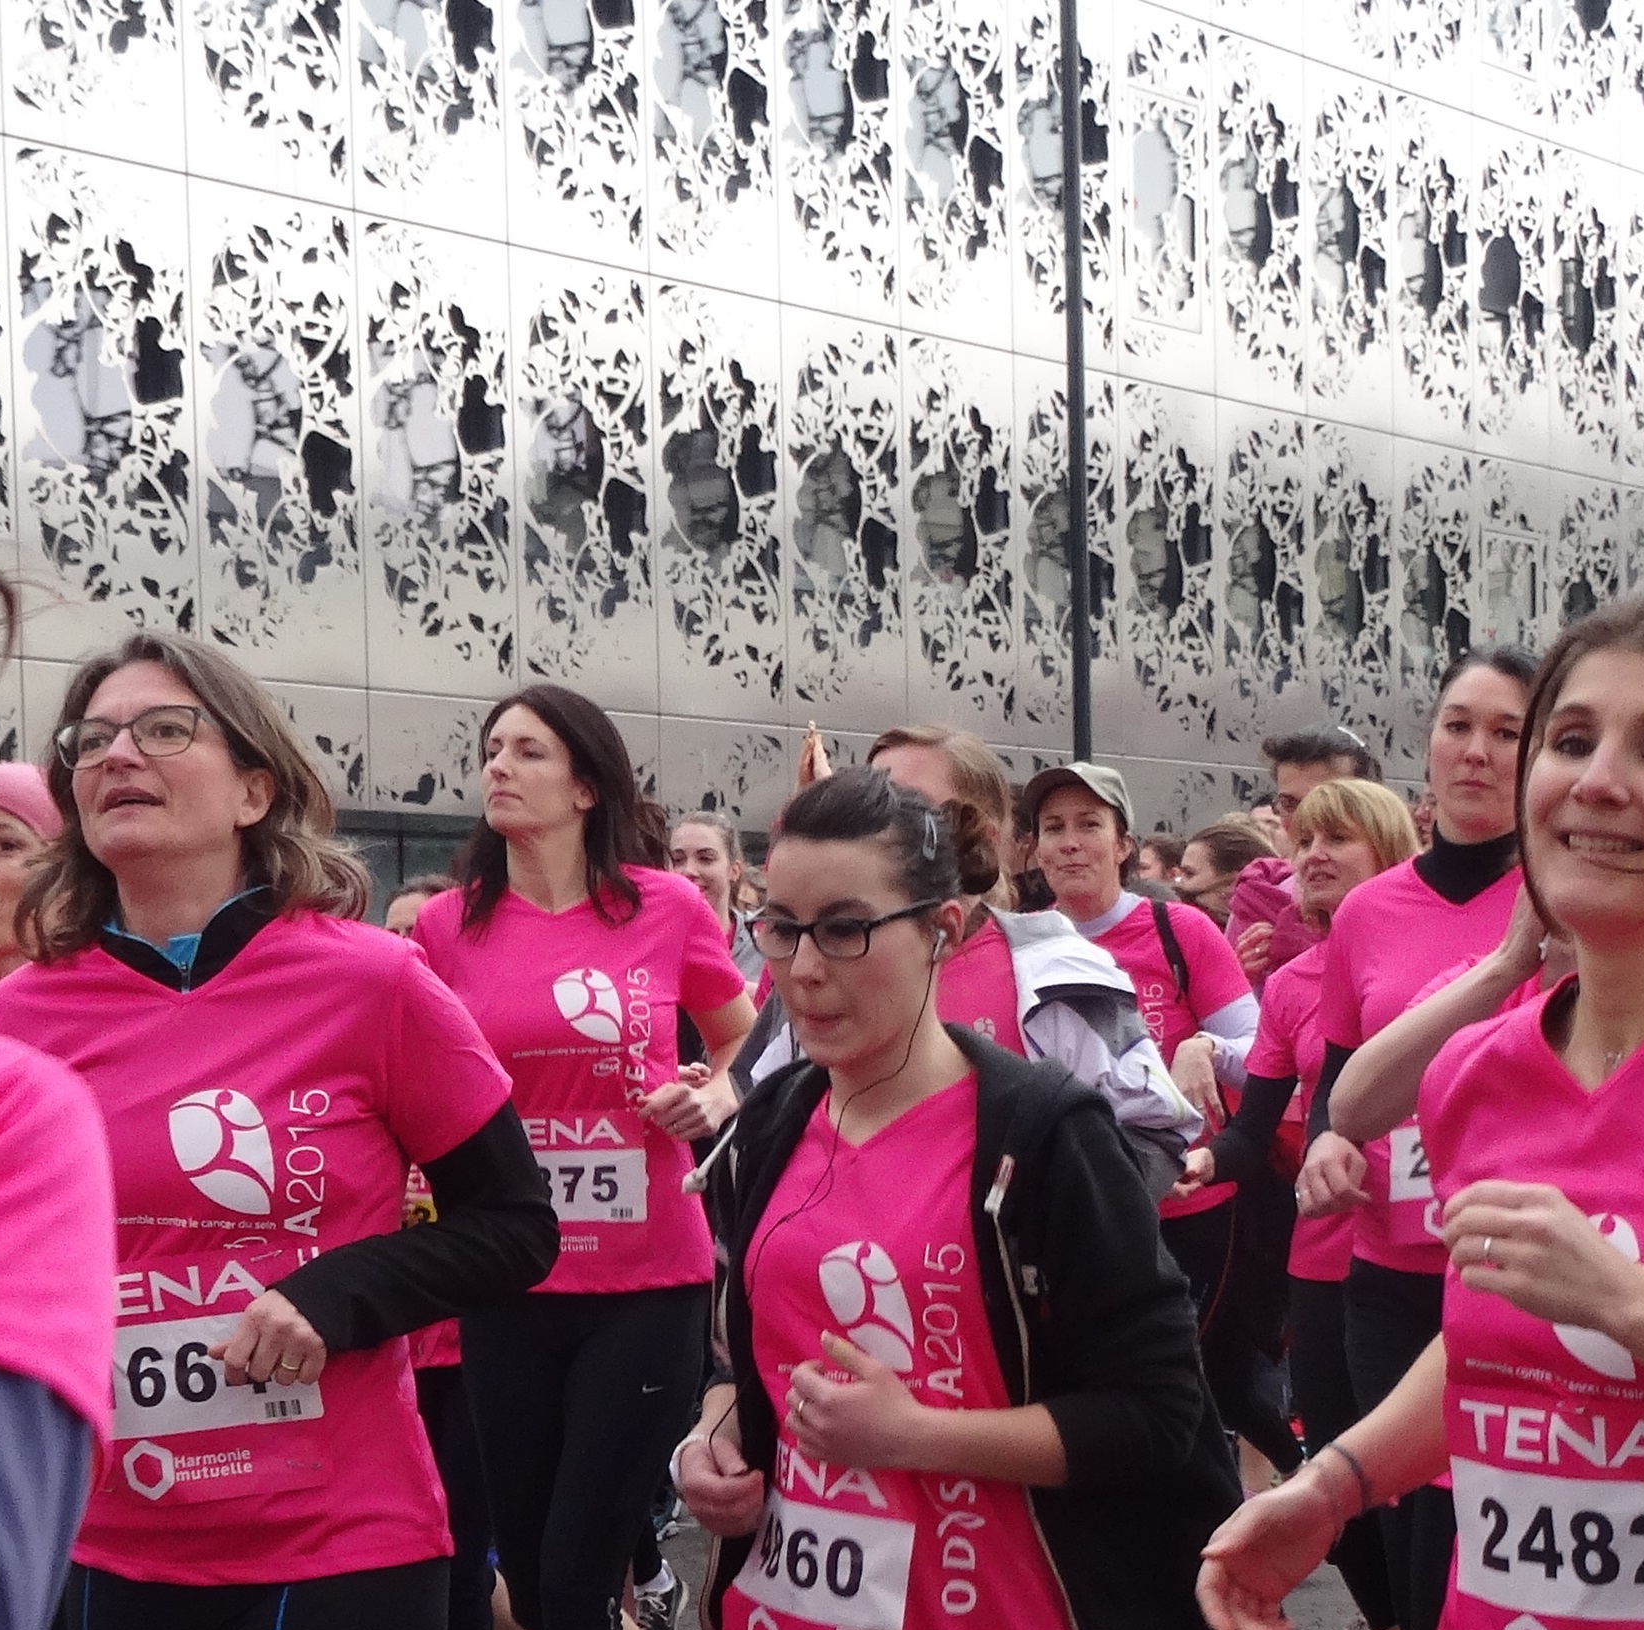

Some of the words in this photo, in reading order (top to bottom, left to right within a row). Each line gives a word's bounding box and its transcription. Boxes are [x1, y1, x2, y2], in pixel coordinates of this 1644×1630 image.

[521, 1116, 626, 1147] ENA
[117, 1214, 155, 1226] semble
[156, 1215, 188, 1228] contre
[200, 1219, 236, 1230] cancer
[254, 1219, 277, 1230] sein
[114, 1259, 266, 1318] ENA
[174, 1448, 252, 1469] Harmonie
[174, 1463, 254, 1484] mutuelle
